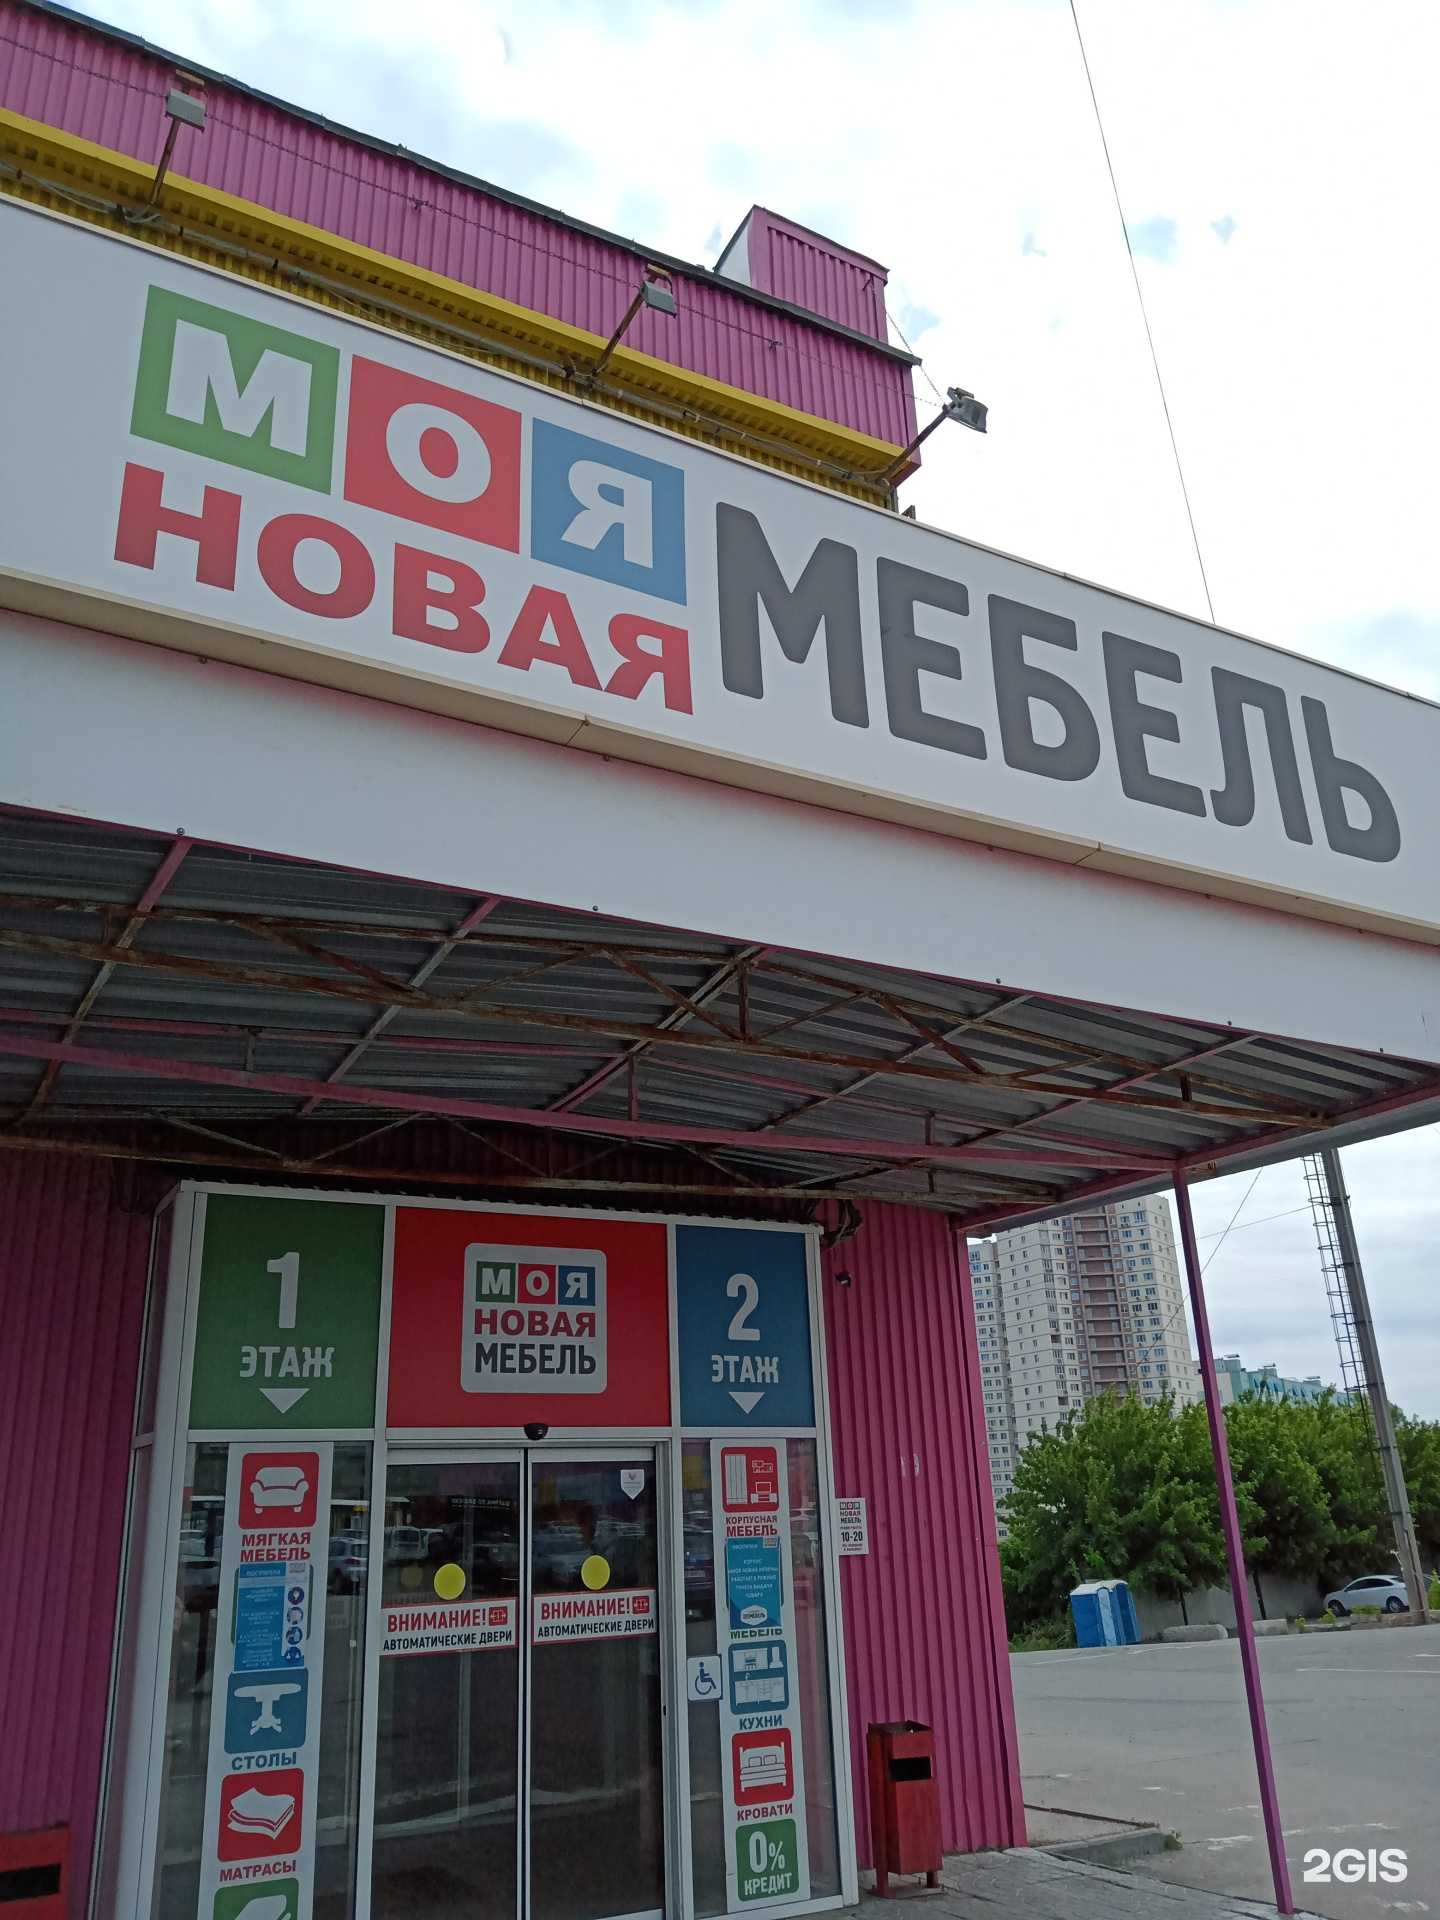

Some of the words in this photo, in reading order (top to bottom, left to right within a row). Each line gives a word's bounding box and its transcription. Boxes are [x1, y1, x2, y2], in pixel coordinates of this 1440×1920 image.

[163, 317, 654, 570] МОЯ
[113, 461, 694, 716] НОВАЯ
[715, 501, 1402, 863] МЕБЕЛЬ
[266, 1251, 301, 1329] 1
[480, 1266, 590, 1300] МОЯ
[726, 1273, 761, 1341] 2
[473, 1308, 597, 1338] НОВАЯ
[239, 1345, 335, 1379] ЭТАЖ
[473, 1342, 597, 1376] МЕБЕЛЬ
[710, 1353, 780, 1385] ЭТАЖ
[725, 1515, 778, 1525] КОРПУСНАЯ
[726, 1524, 778, 1538] МЕБЕЛЬ
[241, 1531, 312, 1547] МЯГКАЯ
[841, 1530, 864, 1543] 10-20
[239, 1547, 312, 1563] МЕБЕЛЬ
[387, 1608, 487, 1632] ВНИМАНИЕ!
[541, 1597, 631, 1620] ВНИМАНИЕ!
[537, 1620, 623, 1638] АВТОМАТИЧЕСКИЕ
[624, 1617, 654, 1633] ДВЕРИ
[730, 1627, 784, 1640] МЕБЕЛЬ
[383, 1632, 477, 1651] АВТОМАТИЧЕСКИЕ
[479, 1630, 512, 1645] ДВЕРИ
[739, 1714, 783, 1731] КУХНИ
[231, 1752, 297, 1771] СТОЛЫ
[736, 1802, 793, 1822] КРОВАТИ
[749, 1830, 786, 1874] 0%
[219, 1859, 297, 1882] МАТРАСЫ
[744, 1872, 792, 1896] КРЕДИТ
